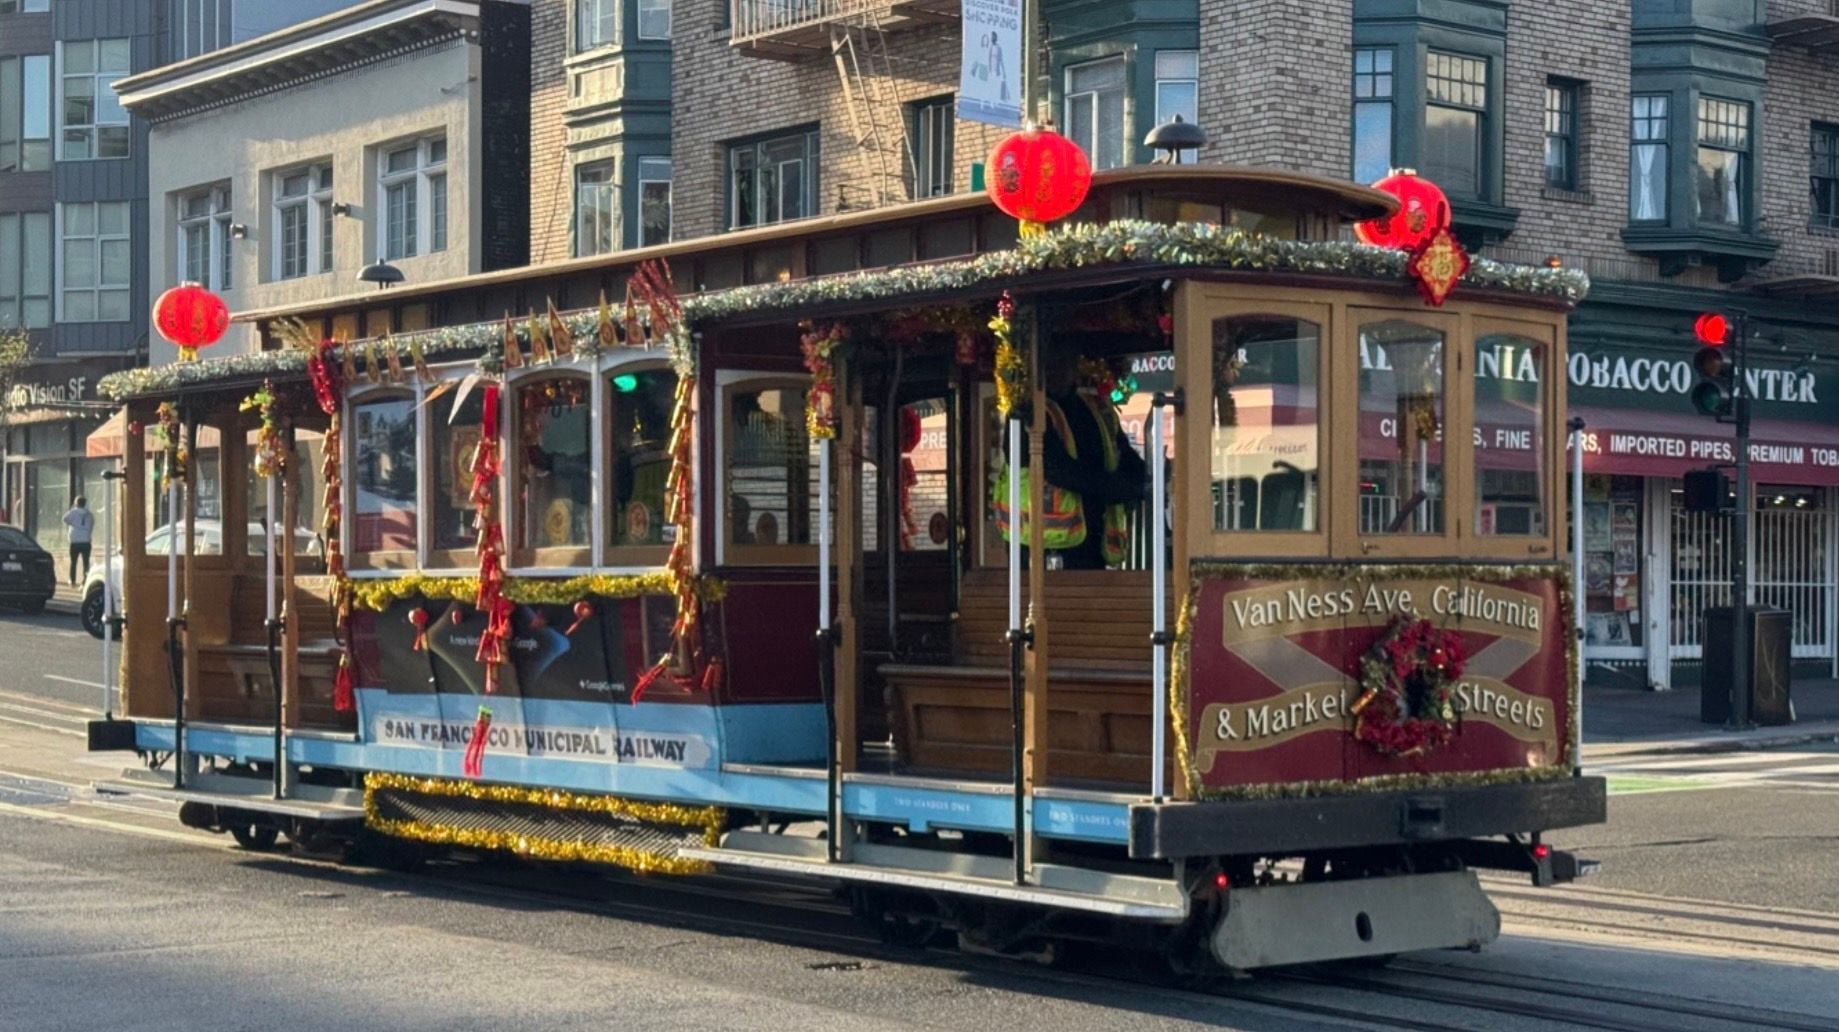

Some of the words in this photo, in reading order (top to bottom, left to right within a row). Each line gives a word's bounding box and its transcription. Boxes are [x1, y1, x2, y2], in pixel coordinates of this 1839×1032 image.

[29, 380, 65, 405] Vision
[68, 376, 86, 400] SF
[1566, 352, 1692, 394] OBACCO
[1496, 430, 1531, 449] FINE
[1610, 434, 1686, 457] IMPORTED
[1690, 440, 1736, 463] PIPES,
[1747, 443, 1804, 464] REMIUM
[1810, 447, 1839, 466] TOB
[1232, 597, 1282, 629] Van
[1286, 588, 1354, 621] Ness
[1433, 585, 1540, 630] California
[1217, 708, 1238, 740] &
[1248, 689, 1347, 738] Market
[1456, 682, 1545, 729] Streets
[385, 720, 416, 740] SAN
[420, 723, 509, 748] FRANCCO
